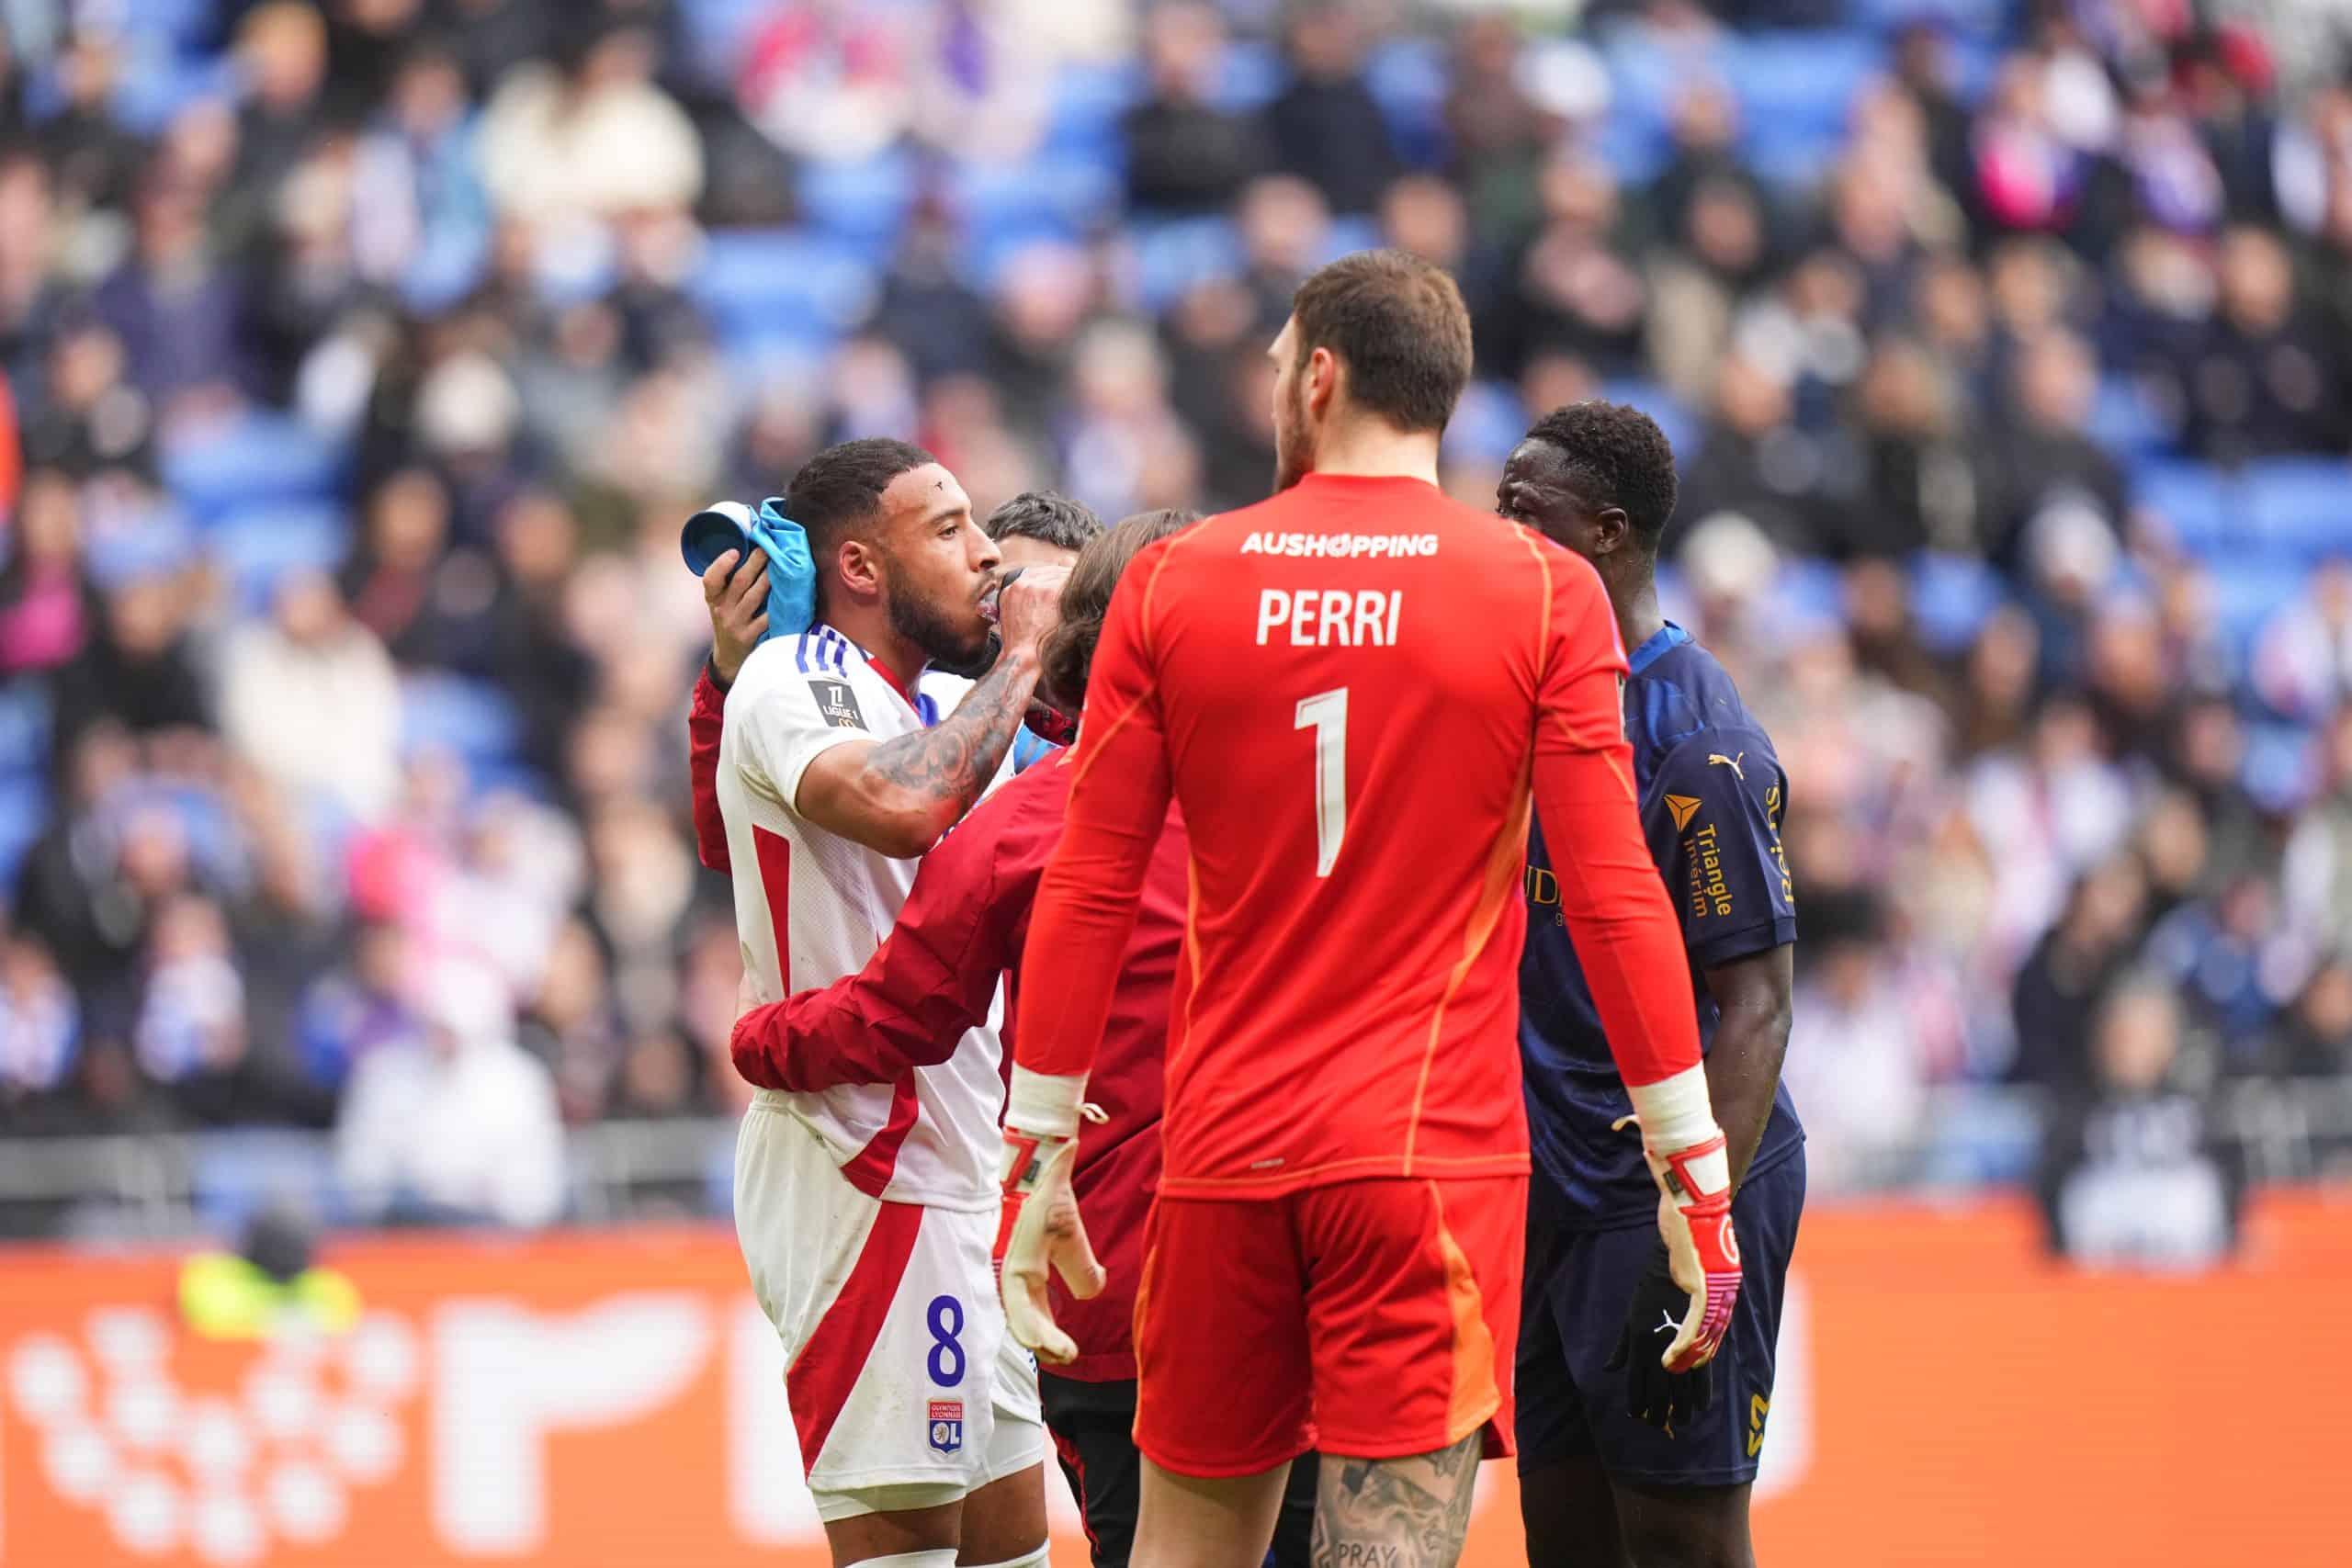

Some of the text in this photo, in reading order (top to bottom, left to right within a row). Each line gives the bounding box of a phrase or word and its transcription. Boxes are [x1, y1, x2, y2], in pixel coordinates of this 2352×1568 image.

[1240, 532, 1439, 558] AUSHOPPING
[1256, 589, 1403, 647] PERRI
[1294, 687, 1349, 878] 1
[1697, 823, 1733, 917] Triangle
[927, 1295, 966, 1387] 8
[1338, 1542, 1397, 1567] PRAY
